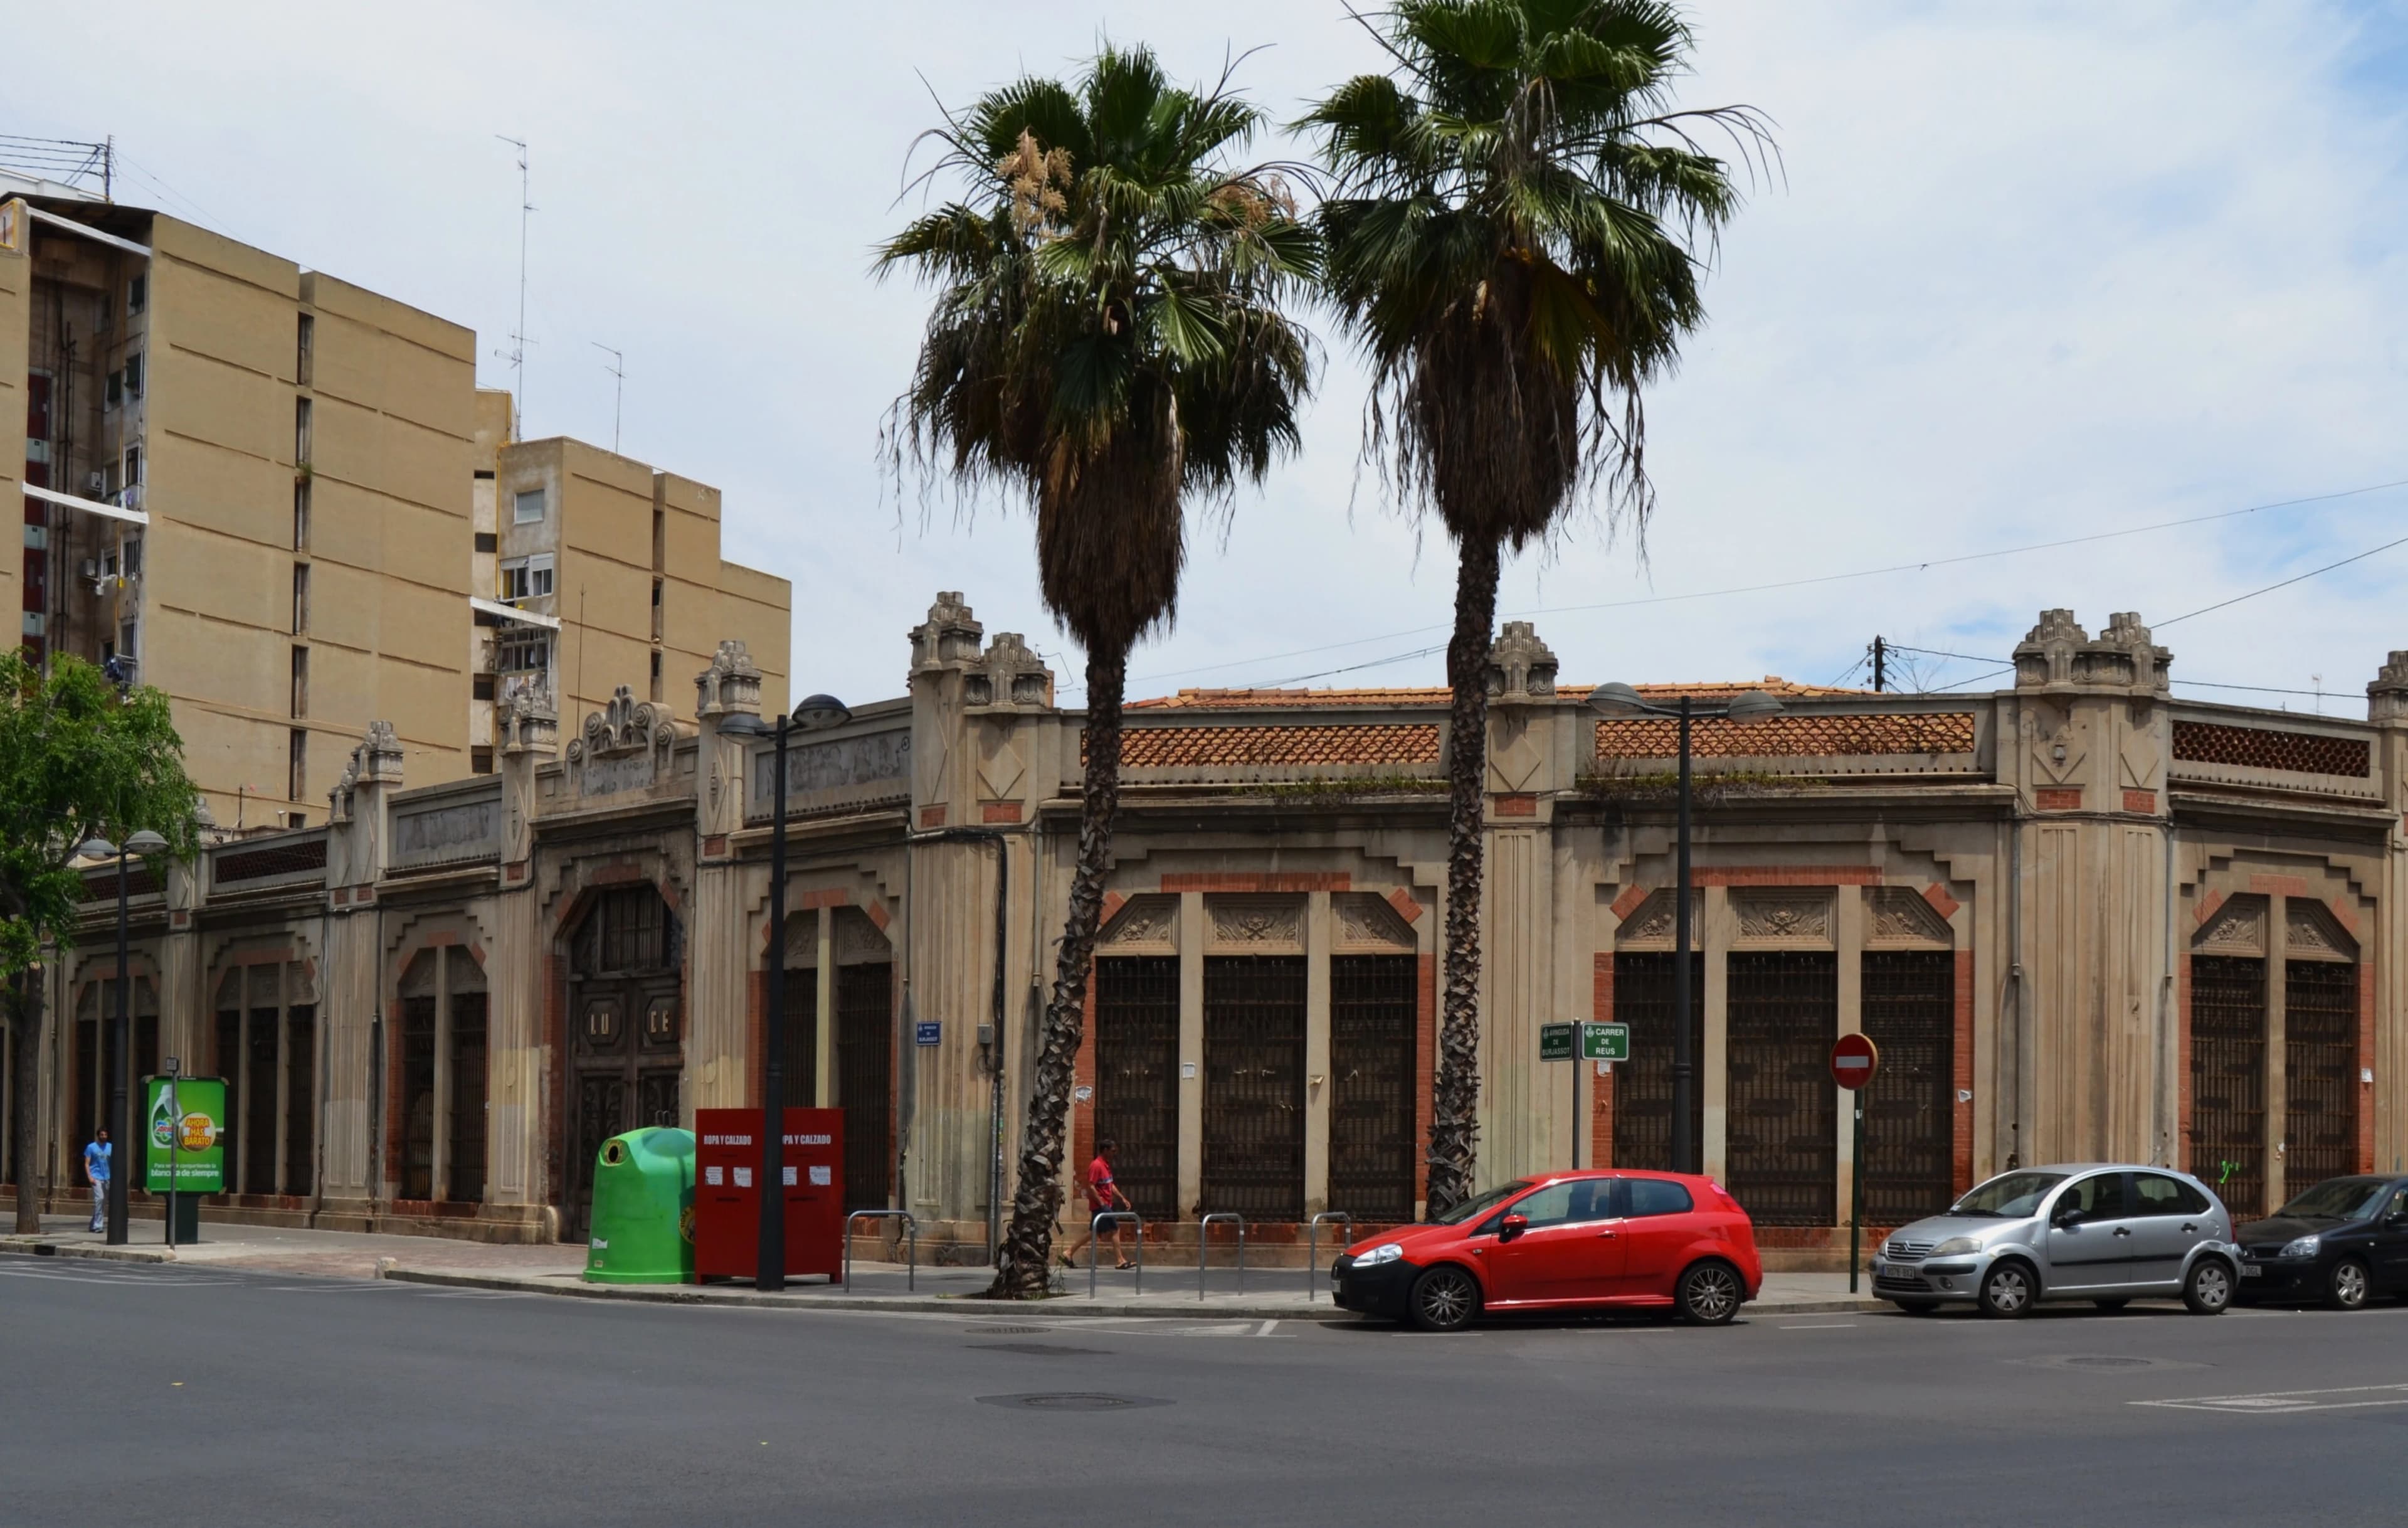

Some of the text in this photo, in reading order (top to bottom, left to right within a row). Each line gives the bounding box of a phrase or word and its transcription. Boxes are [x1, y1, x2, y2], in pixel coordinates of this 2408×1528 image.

[1595, 1028, 1624, 1036] CARRER
[1542, 1047, 1570, 1056] BURJASSOT
[1595, 1047, 1615, 1055] REUS
[187, 1118, 209, 1127] AHORA
[704, 1135, 752, 1145] ROPA Y CALZADO
[795, 1135, 799, 1144] Y
[800, 1135, 832, 1144] CALZADO
[181, 1169, 190, 1177] de
[191, 1169, 219, 1178] siempre
